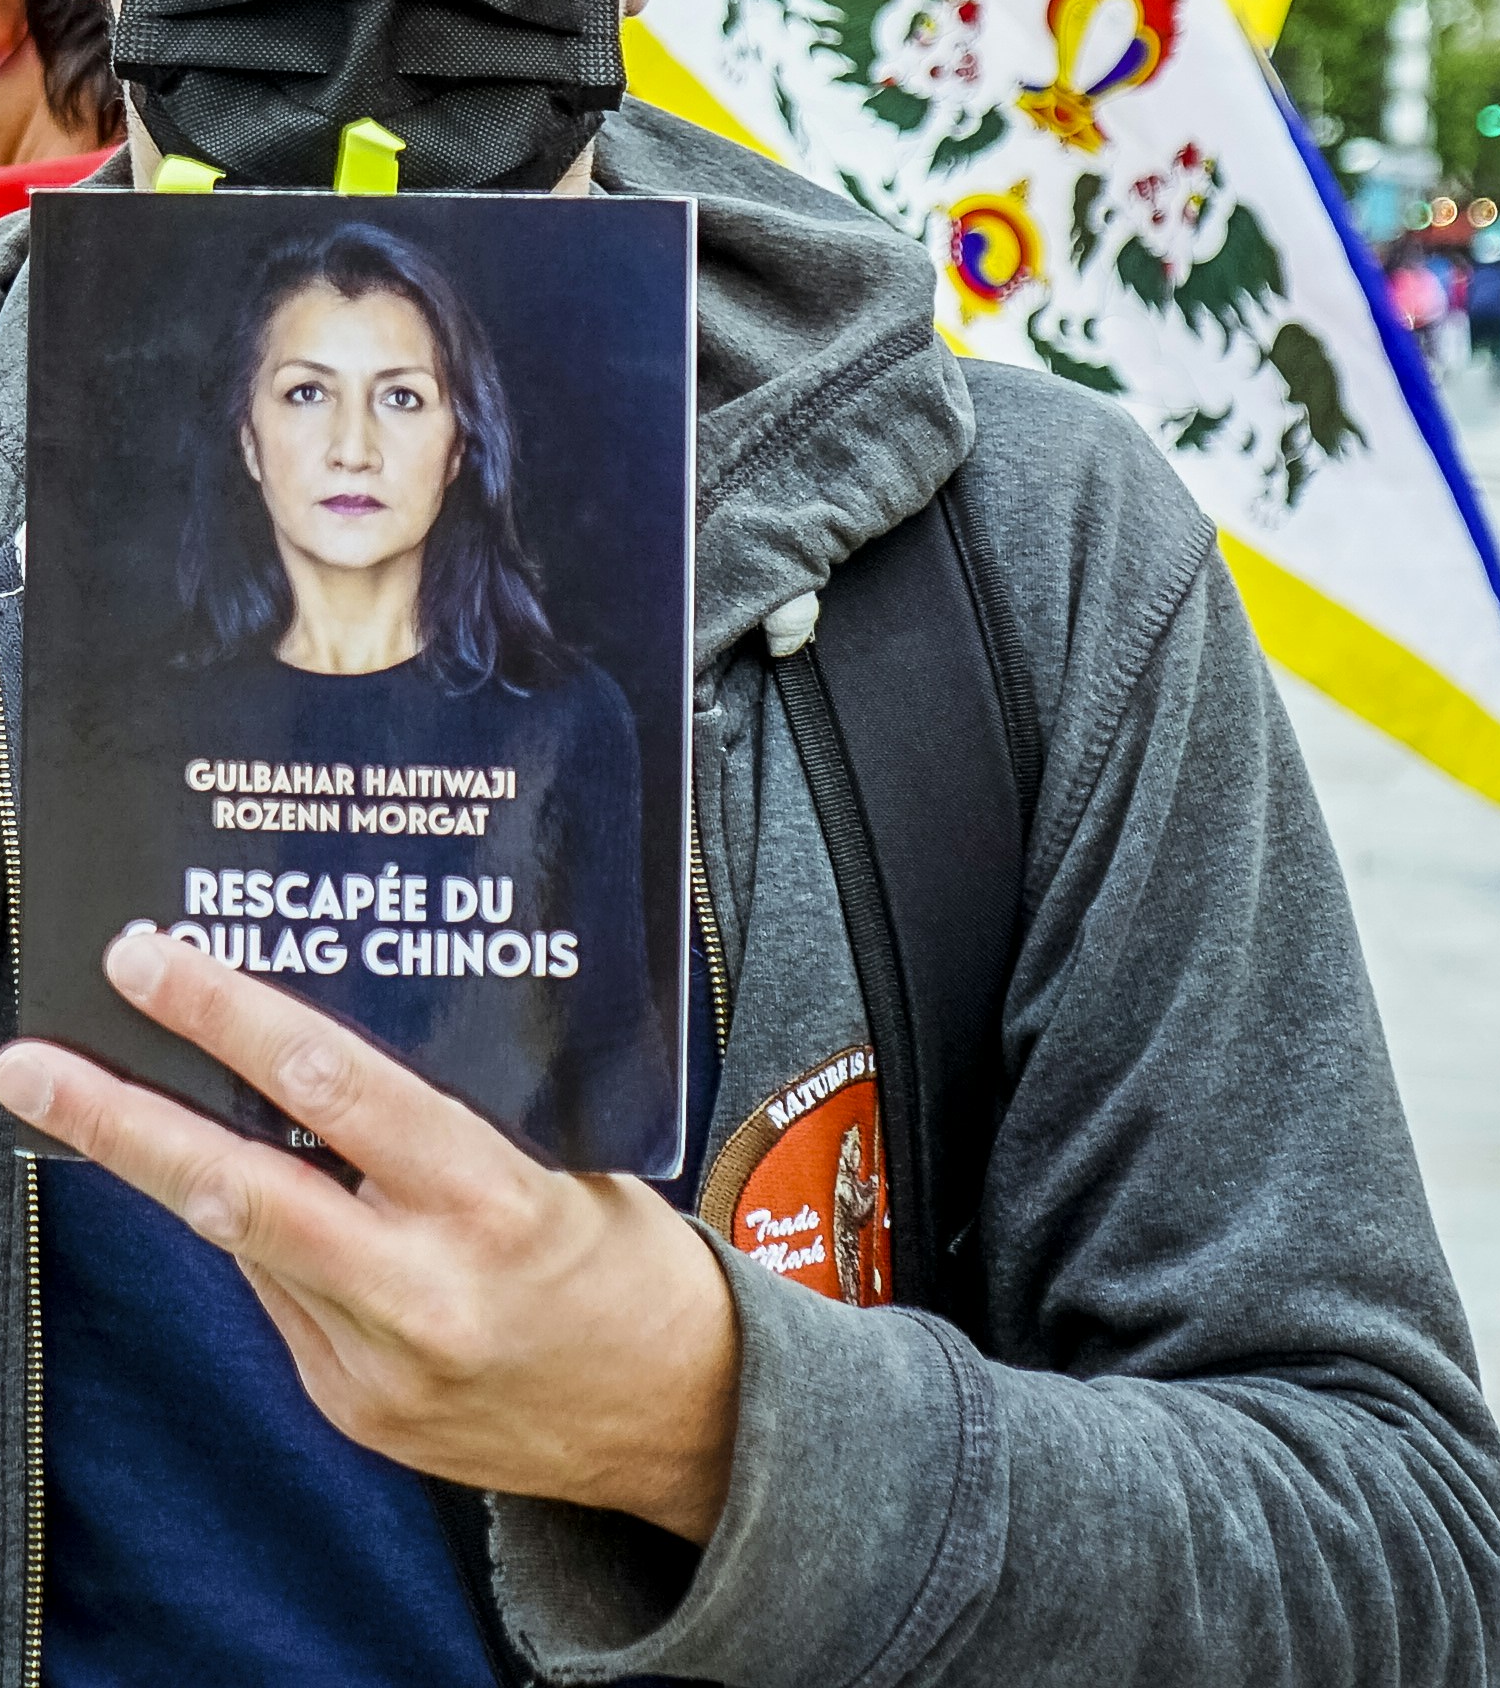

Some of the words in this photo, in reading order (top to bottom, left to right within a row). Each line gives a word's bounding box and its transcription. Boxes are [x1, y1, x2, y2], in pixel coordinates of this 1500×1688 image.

[187, 760, 355, 795] GULBAHAR
[363, 766, 516, 799] HAITIWAJI
[213, 798, 340, 832] ROZENN
[350, 804, 490, 836] MORGAT
[187, 863, 428, 923] RESCAPÉE
[443, 876, 514, 923] DU
[124, 921, 348, 975] OULAG
[363, 929, 579, 978] CHINOIS
[766, 1056, 848, 1130] NATURE
[745, 1203, 821, 1243] Trade
[749, 1234, 826, 1273] Mark
